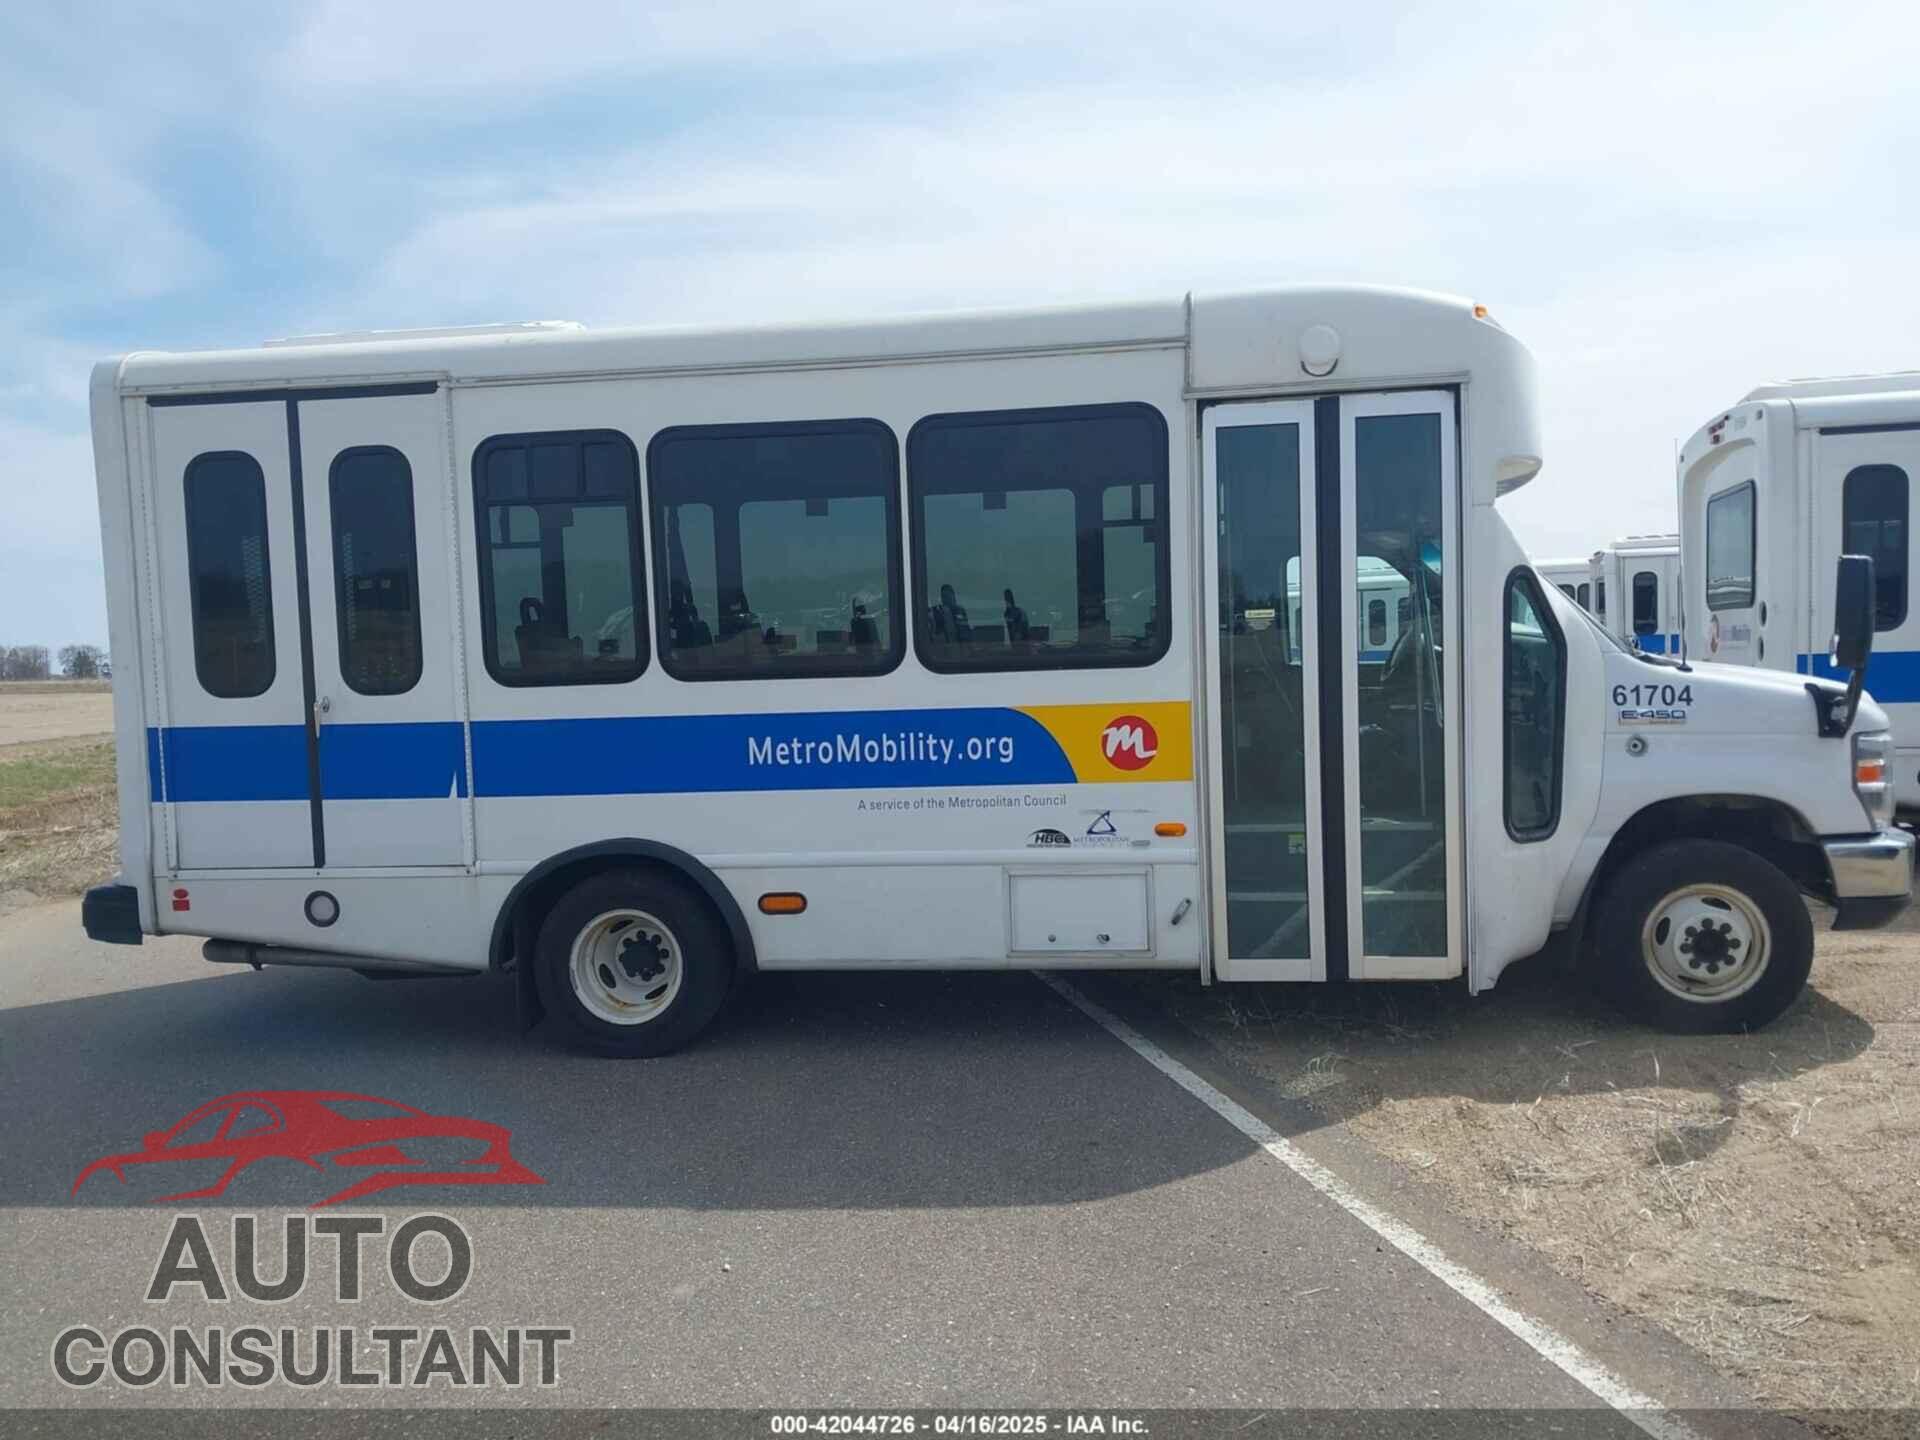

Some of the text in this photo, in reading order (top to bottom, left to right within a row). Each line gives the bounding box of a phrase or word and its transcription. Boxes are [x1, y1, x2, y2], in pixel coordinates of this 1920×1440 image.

[1612, 684, 1694, 707] 61704
[748, 732, 1014, 765] MetroMobility.org
[857, 794, 1067, 811] A service of the Metropolitan Council
